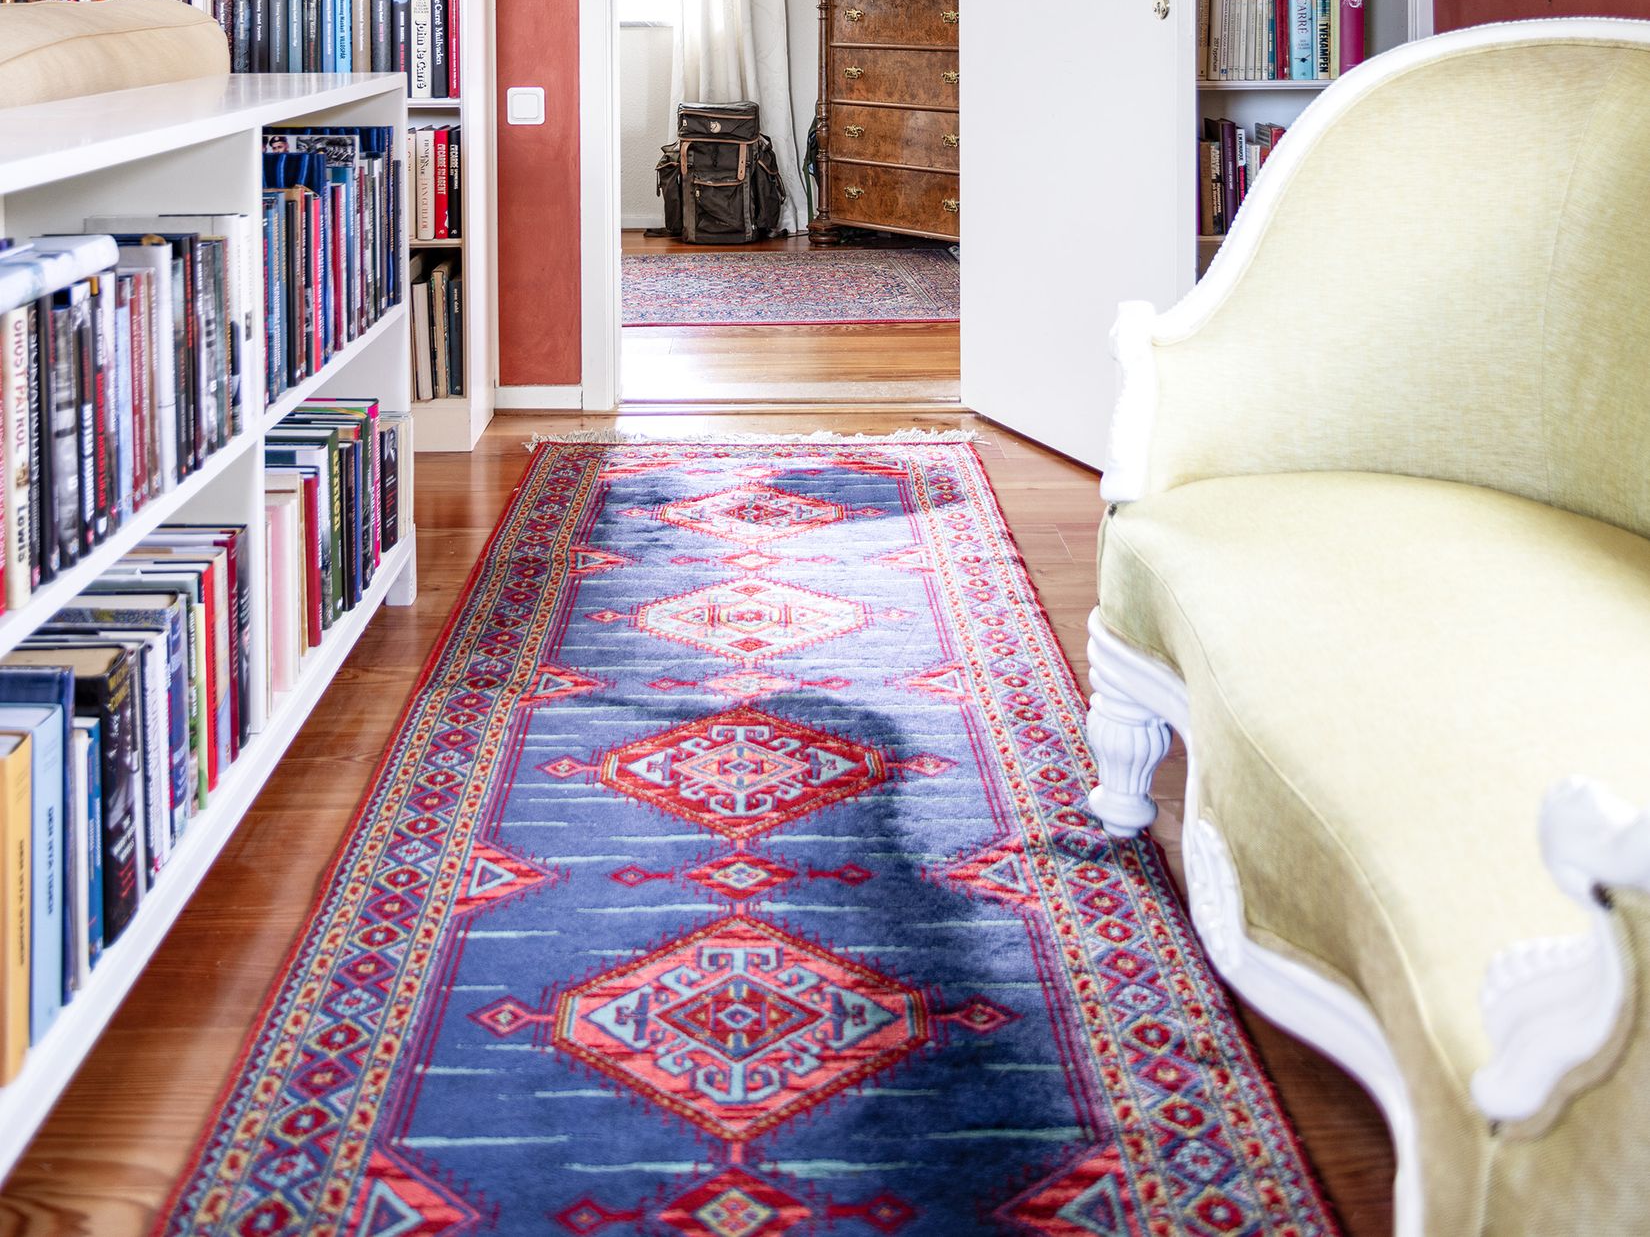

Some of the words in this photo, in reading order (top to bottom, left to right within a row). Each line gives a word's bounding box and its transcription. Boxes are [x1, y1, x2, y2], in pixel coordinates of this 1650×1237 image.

[434, 4, 443, 26] Carré
[415, 21, 427, 45] John
[435, 27, 443, 65] Mullvaden
[416, 48, 427, 60] le
[1318, 22, 1329, 73] TVEKAMPEN
[416, 61, 427, 89] Carré
[437, 176, 446, 195] AGENT
[14, 320, 28, 378] GHOST
[15, 385, 26, 453] PATROL
